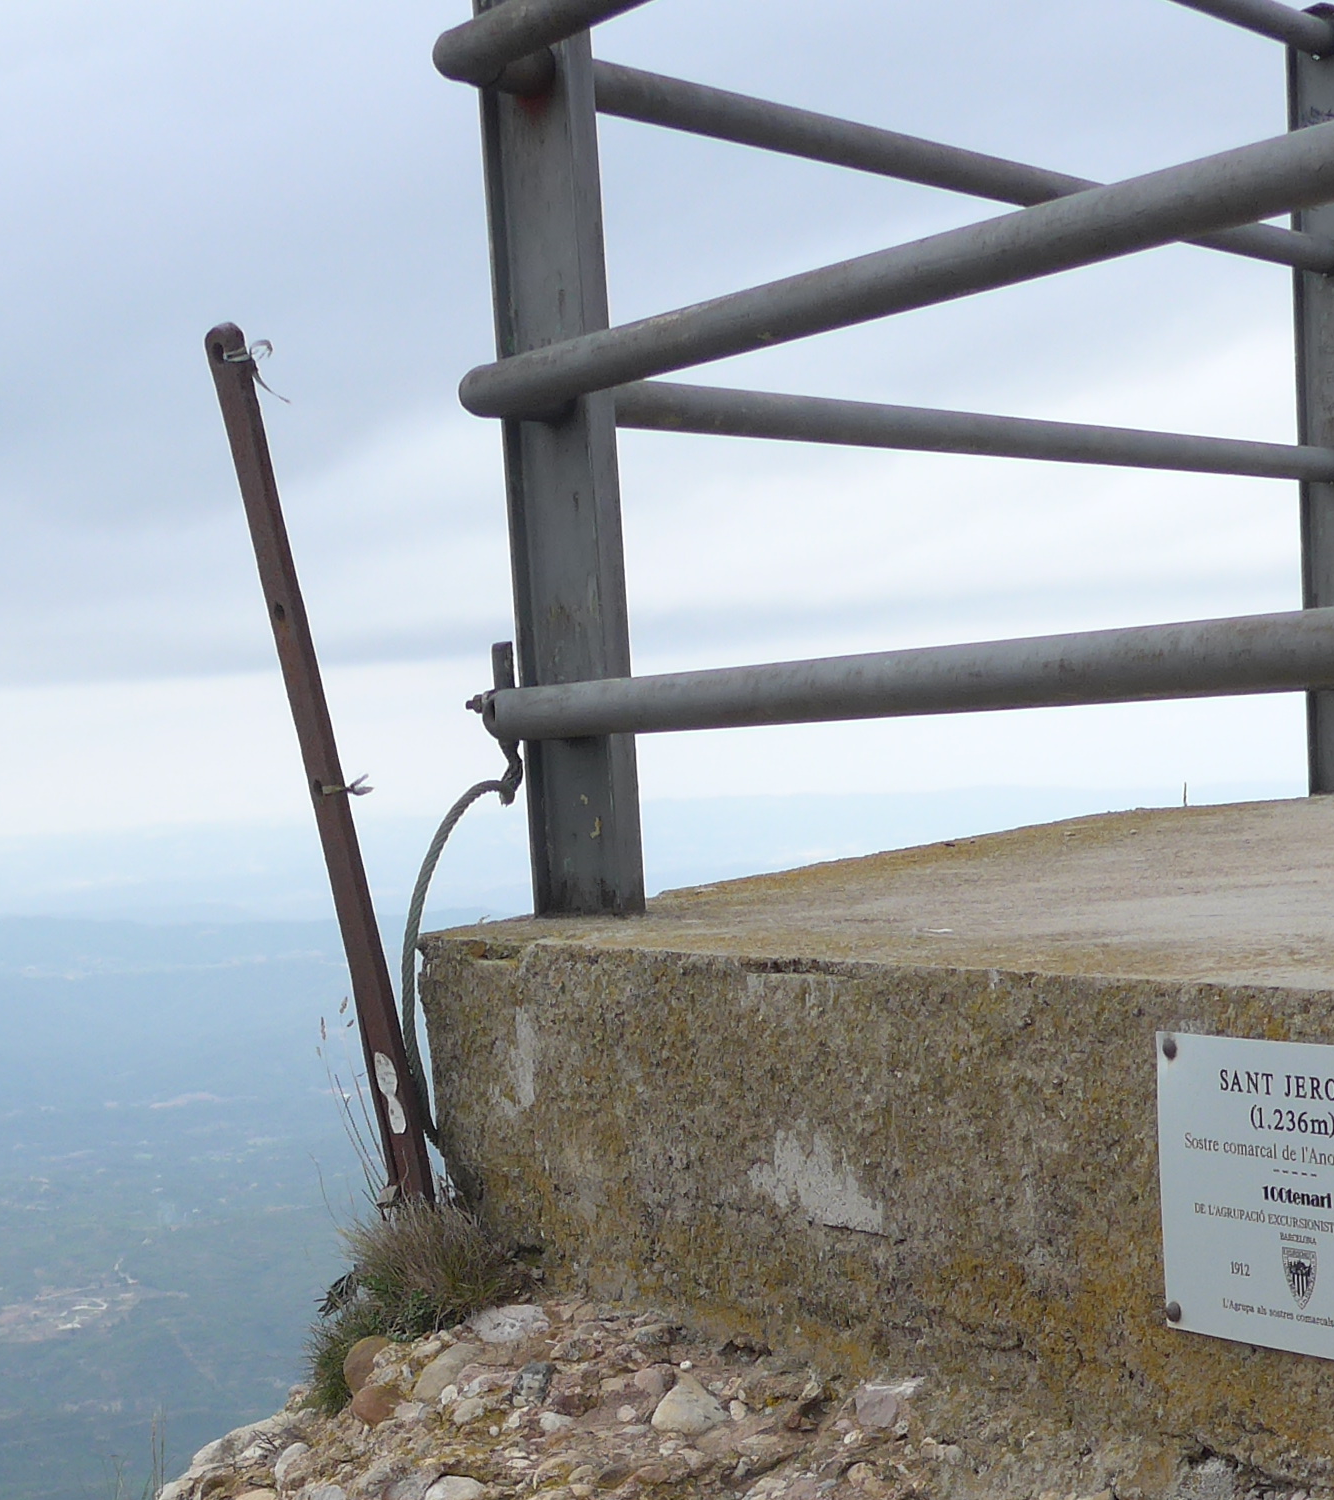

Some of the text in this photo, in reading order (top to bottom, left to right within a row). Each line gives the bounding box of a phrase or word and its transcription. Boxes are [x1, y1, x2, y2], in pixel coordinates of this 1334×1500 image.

[1219, 1069, 1273, 1096] SANT
[1185, 1133, 1219, 1152] Sostre
[1223, 1141, 1277, 1160] comarcal
[1282, 1146, 1297, 1162] de
[1194, 1202, 1206, 1215] DE
[1208, 1204, 1265, 1224] L'AGRUPACIÓ
[1230, 1261, 1251, 1277] 1912
[1222, 1299, 1255, 1315] L'Agrupa
[1256, 1304, 1267, 1316] als
[1269, 1307, 1294, 1321] sostres
[1296, 1312, 1334, 1328] comarcals
